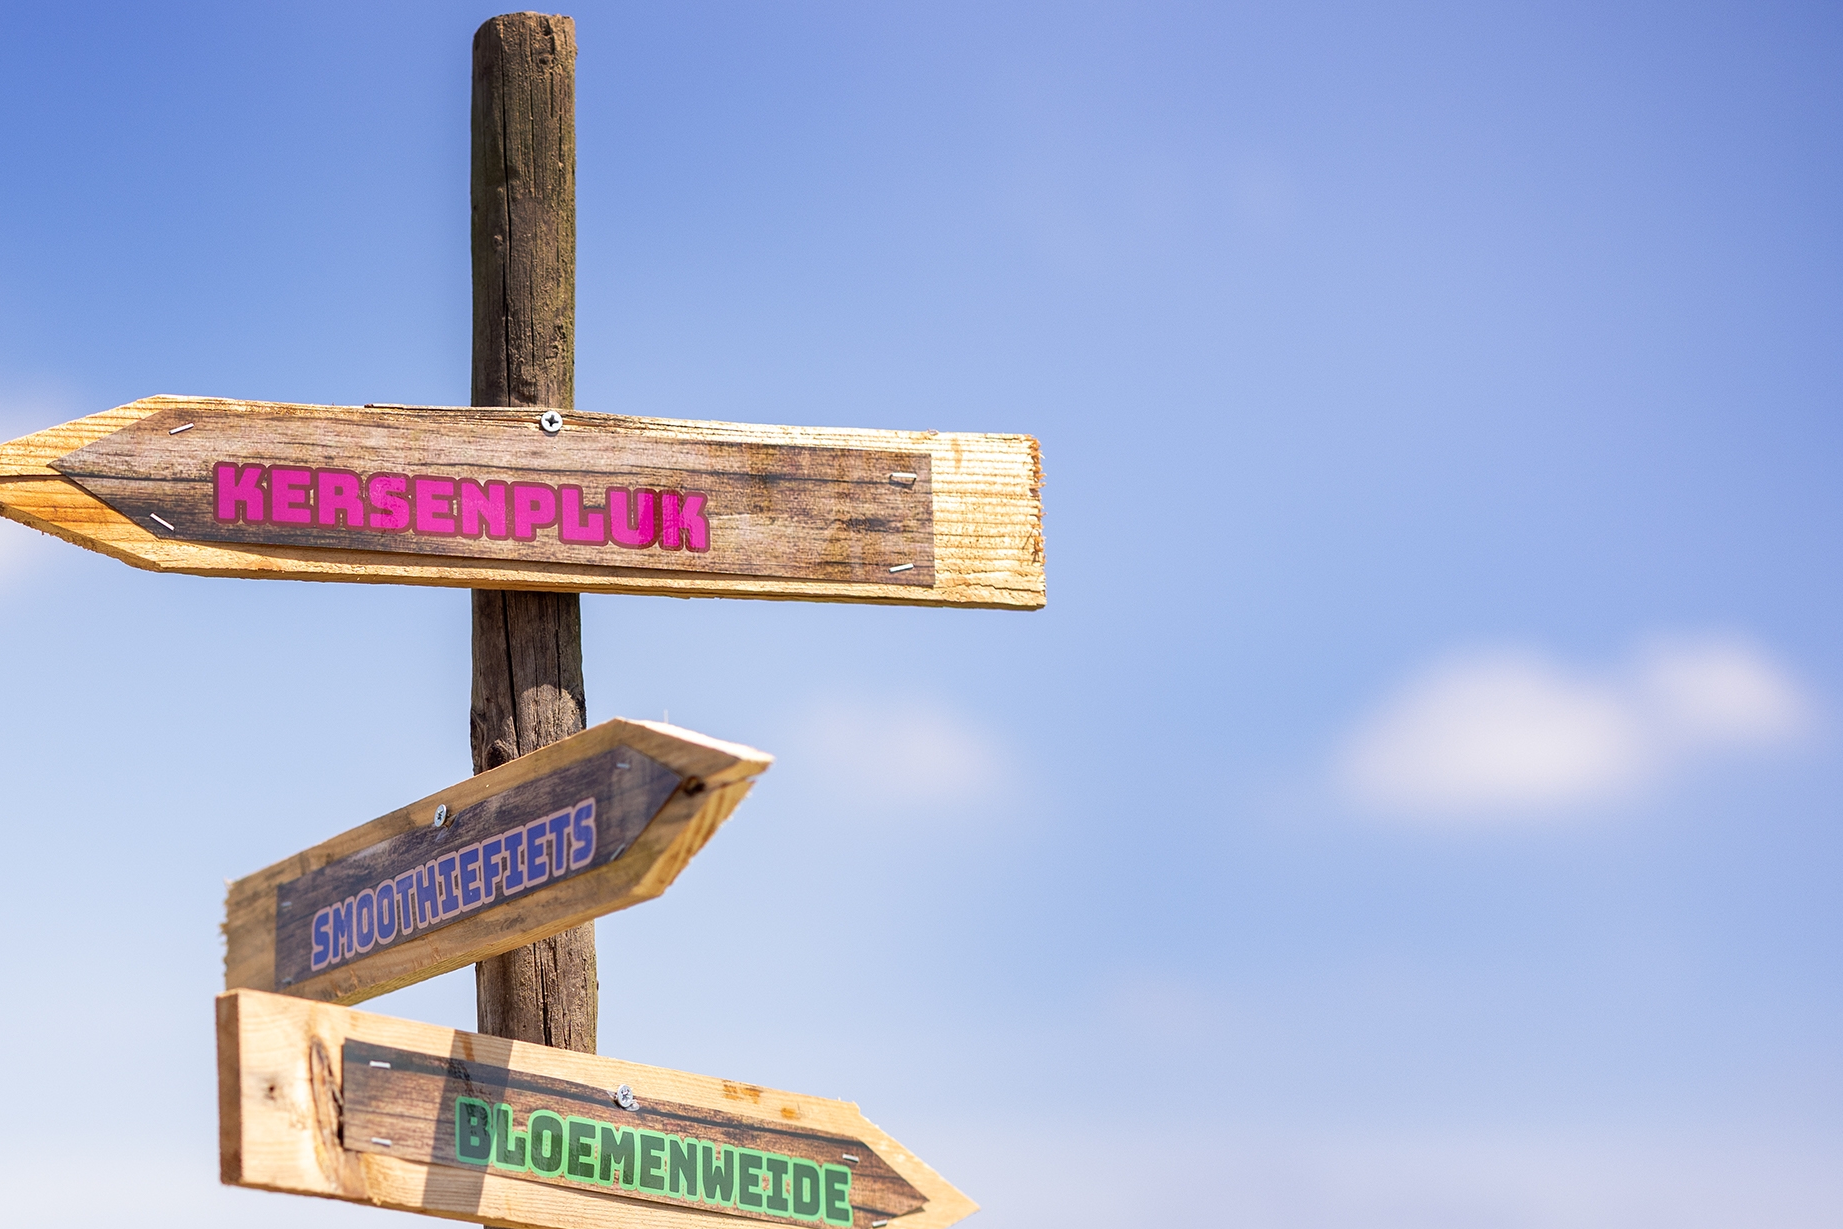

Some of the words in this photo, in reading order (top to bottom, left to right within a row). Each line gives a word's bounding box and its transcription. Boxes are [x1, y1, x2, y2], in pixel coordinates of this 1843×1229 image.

[212, 461, 711, 553] KERSENPLUK
[309, 797, 597, 972] SMOOTHIEFIETS
[455, 1096, 854, 1228] BLOEMENWEIDE
